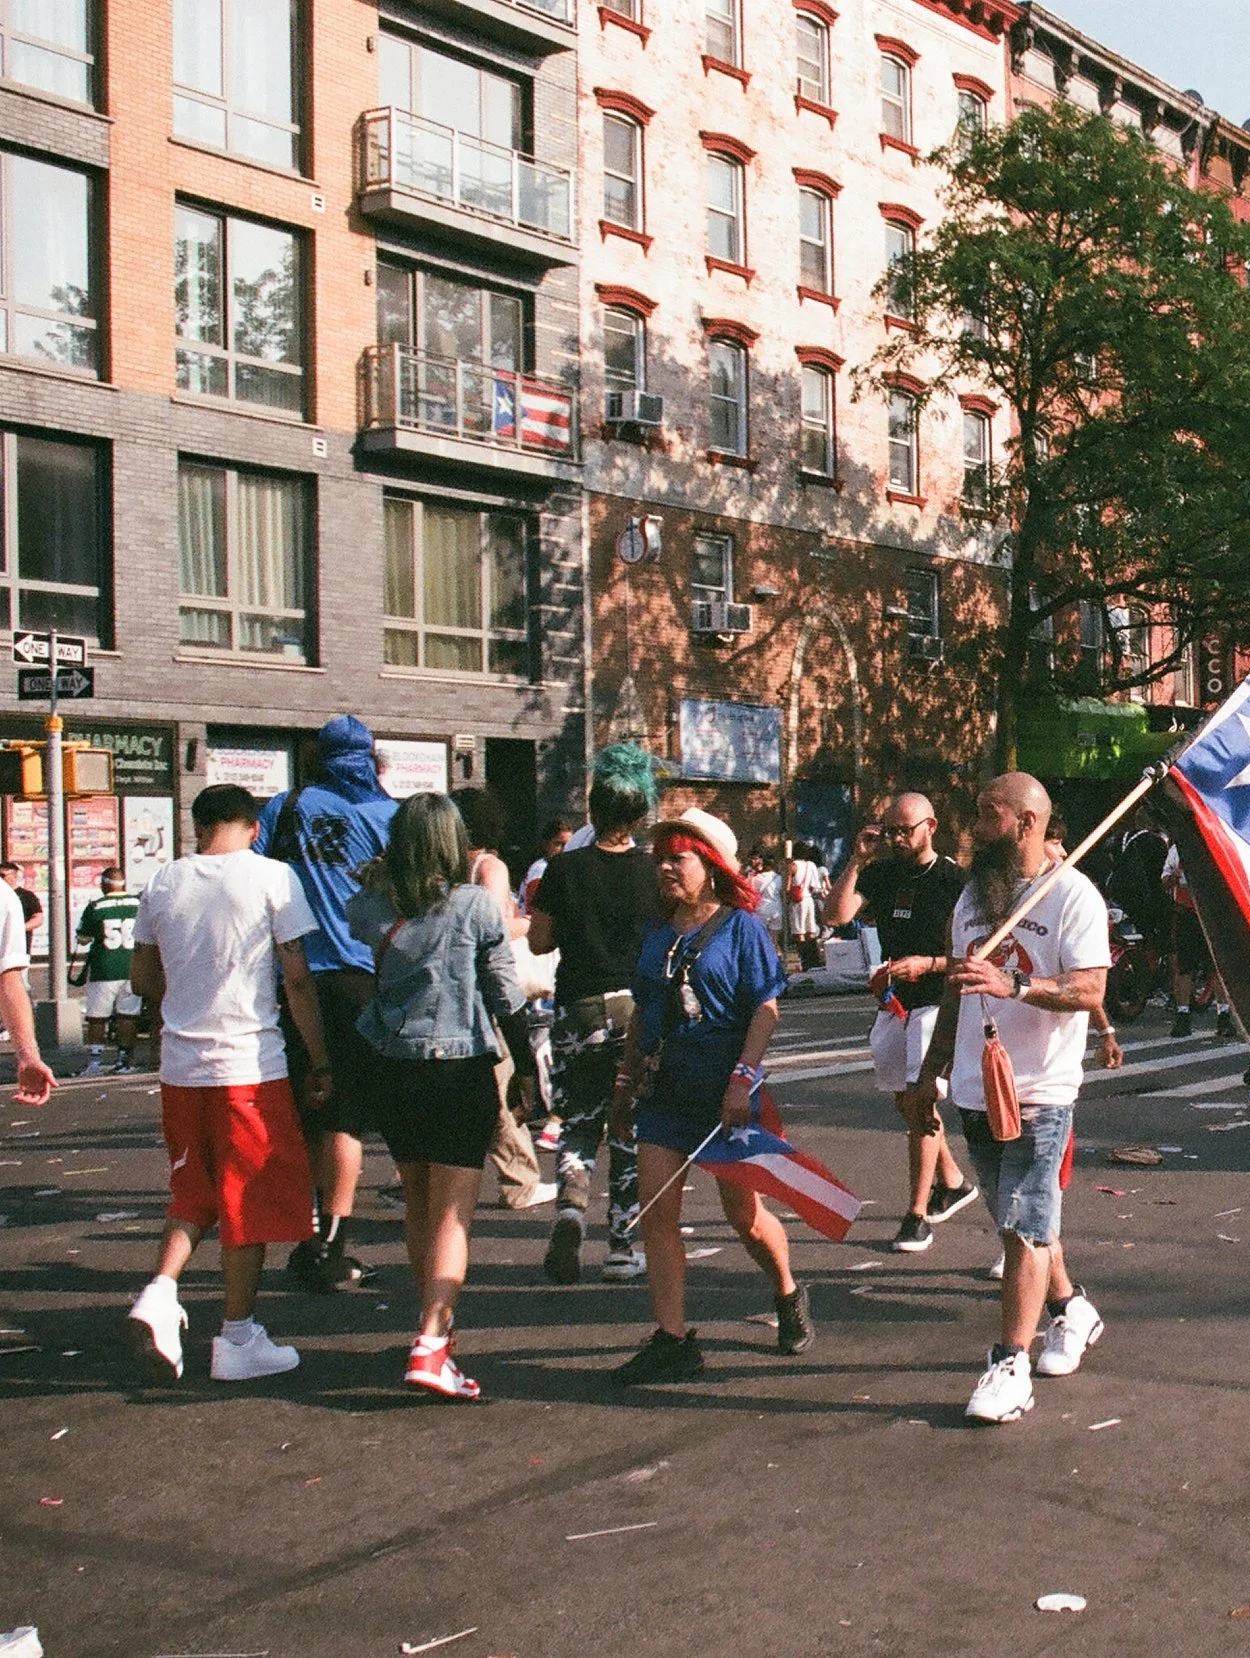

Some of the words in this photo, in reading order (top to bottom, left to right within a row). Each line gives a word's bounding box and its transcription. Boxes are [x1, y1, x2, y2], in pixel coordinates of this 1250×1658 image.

[22, 641, 46, 656] ONE
[57, 646, 80, 658] WAY
[29, 678, 52, 690] ONE
[220, 755, 274, 770] PHARMACY
[395, 763, 442, 774] PHARMACY
